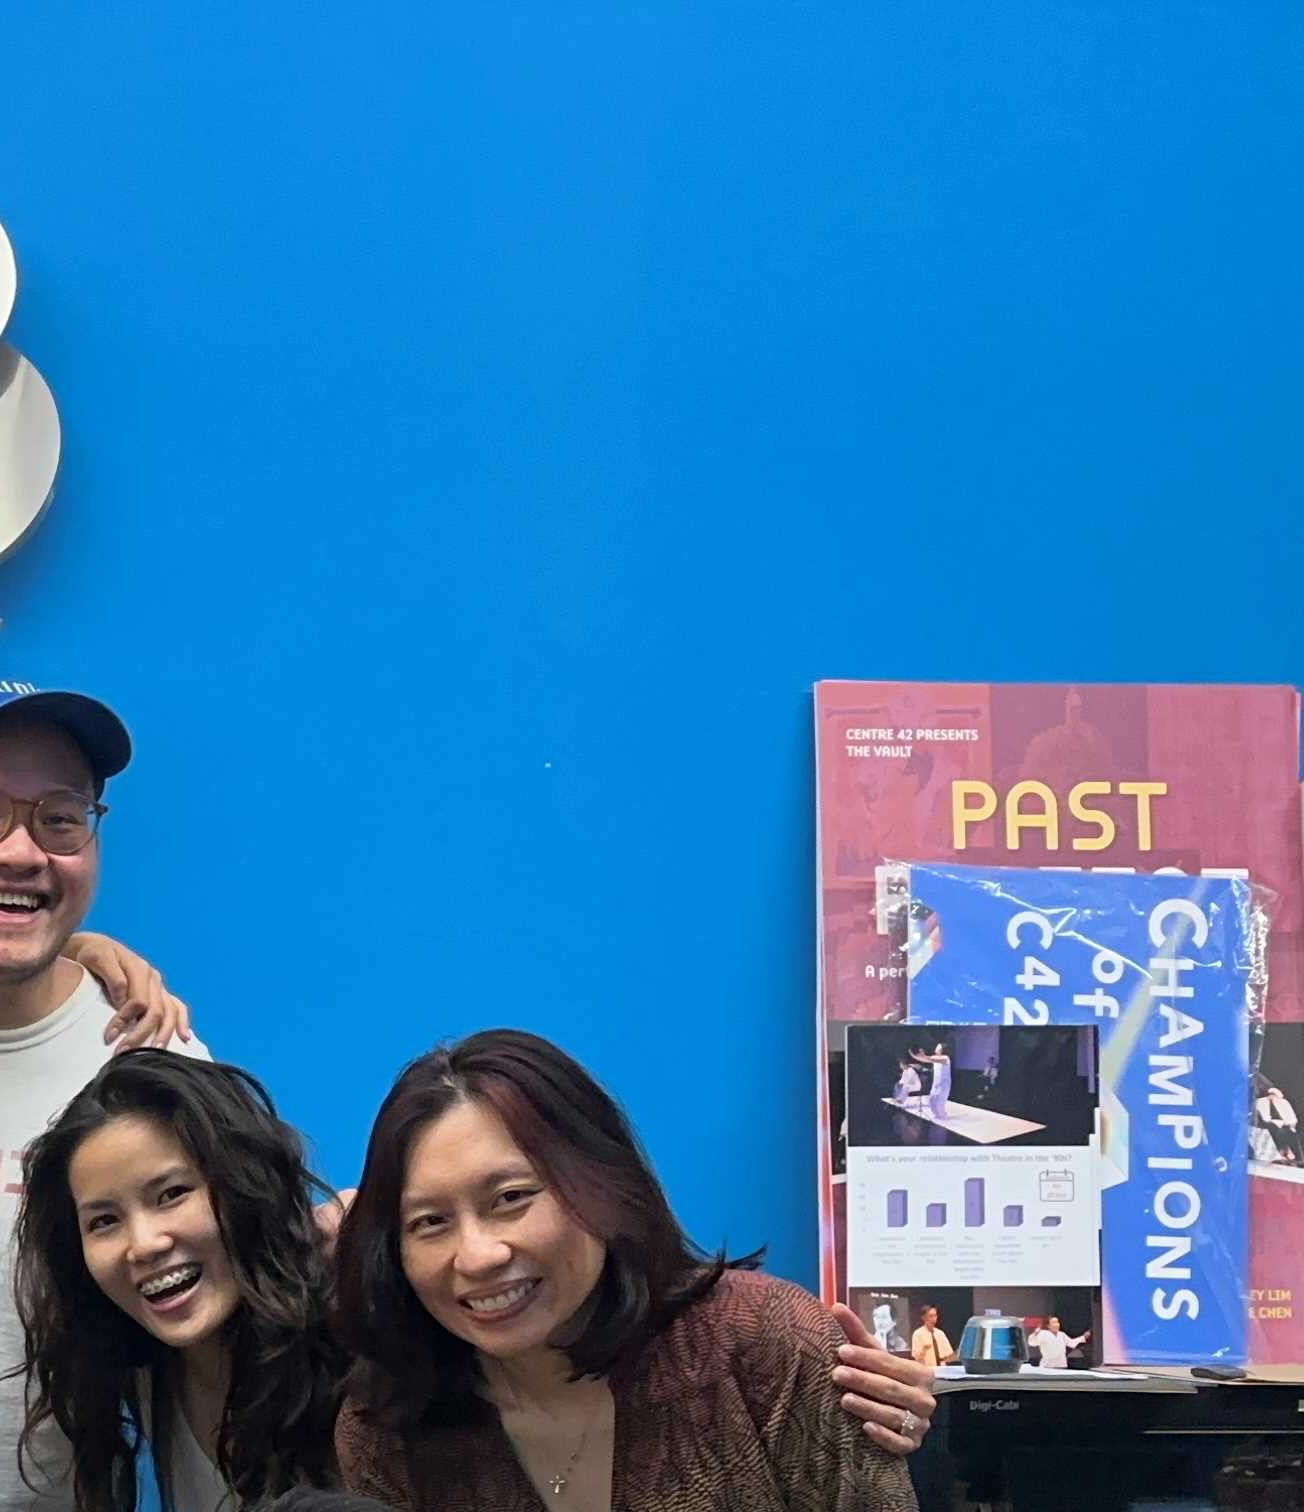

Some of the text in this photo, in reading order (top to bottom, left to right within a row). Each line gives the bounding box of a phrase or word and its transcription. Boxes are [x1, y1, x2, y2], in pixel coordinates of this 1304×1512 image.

[846, 728, 979, 741] CENTRE 42 PRESENTS
[846, 745, 912, 757] THE VAULT
[951, 779, 1168, 851] PAST
[864, 965, 908, 981] A per
[1004, 910, 1061, 1025] C42
[1073, 949, 1125, 1019] of
[1145, 898, 1209, 1321] CHAMPIONS
[1267, 1288, 1292, 1302] LIM
[1258, 1306, 1293, 1319] CHEN
